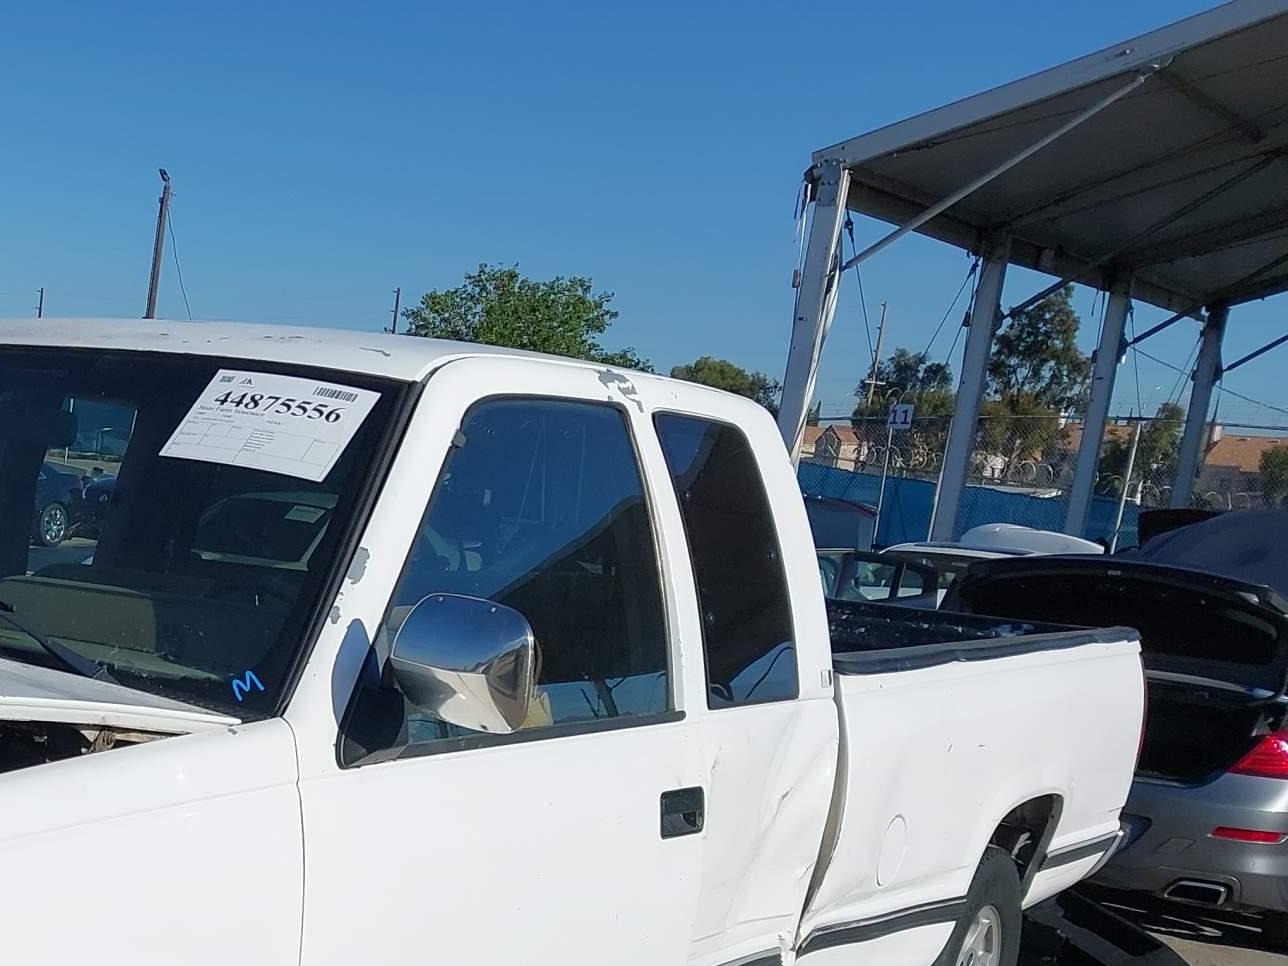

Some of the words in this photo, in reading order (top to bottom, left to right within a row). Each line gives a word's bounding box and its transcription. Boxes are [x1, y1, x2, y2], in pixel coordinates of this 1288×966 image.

[214, 390, 346, 424] 44875556
[889, 408, 910, 425] 11
[232, 670, 265, 702] M
